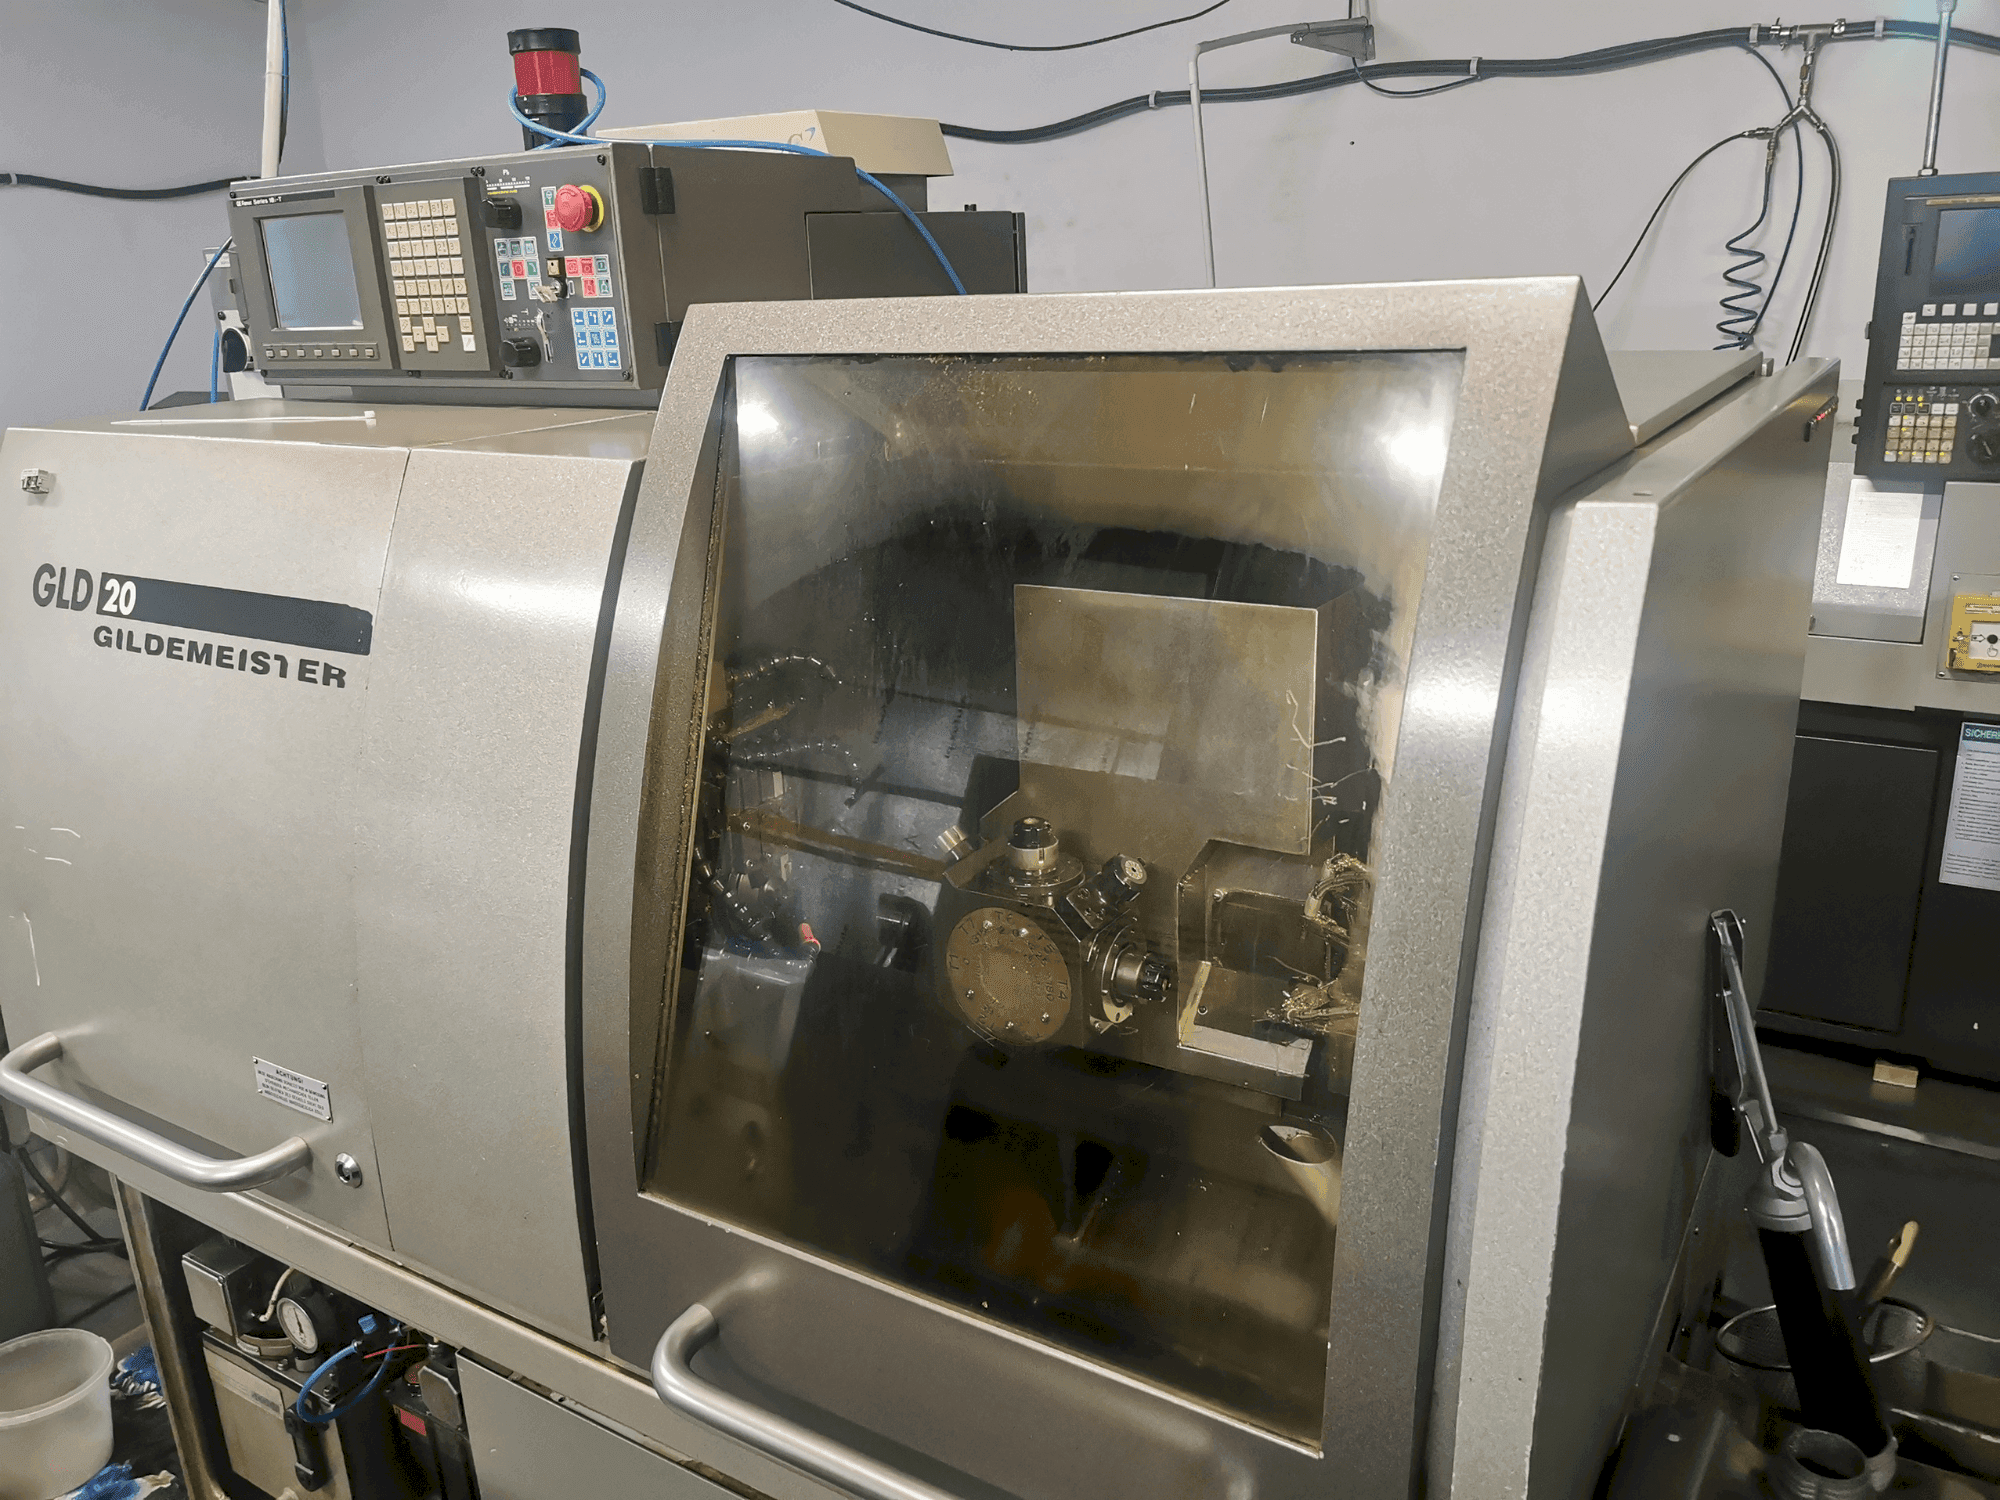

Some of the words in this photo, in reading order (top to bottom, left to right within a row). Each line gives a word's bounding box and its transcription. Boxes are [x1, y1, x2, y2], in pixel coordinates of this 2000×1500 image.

[33, 563, 94, 611] GLD
[102, 578, 137, 616] 20
[93, 625, 348, 689] GILDEMEISTER
[1057, 980, 1069, 1000] T4
